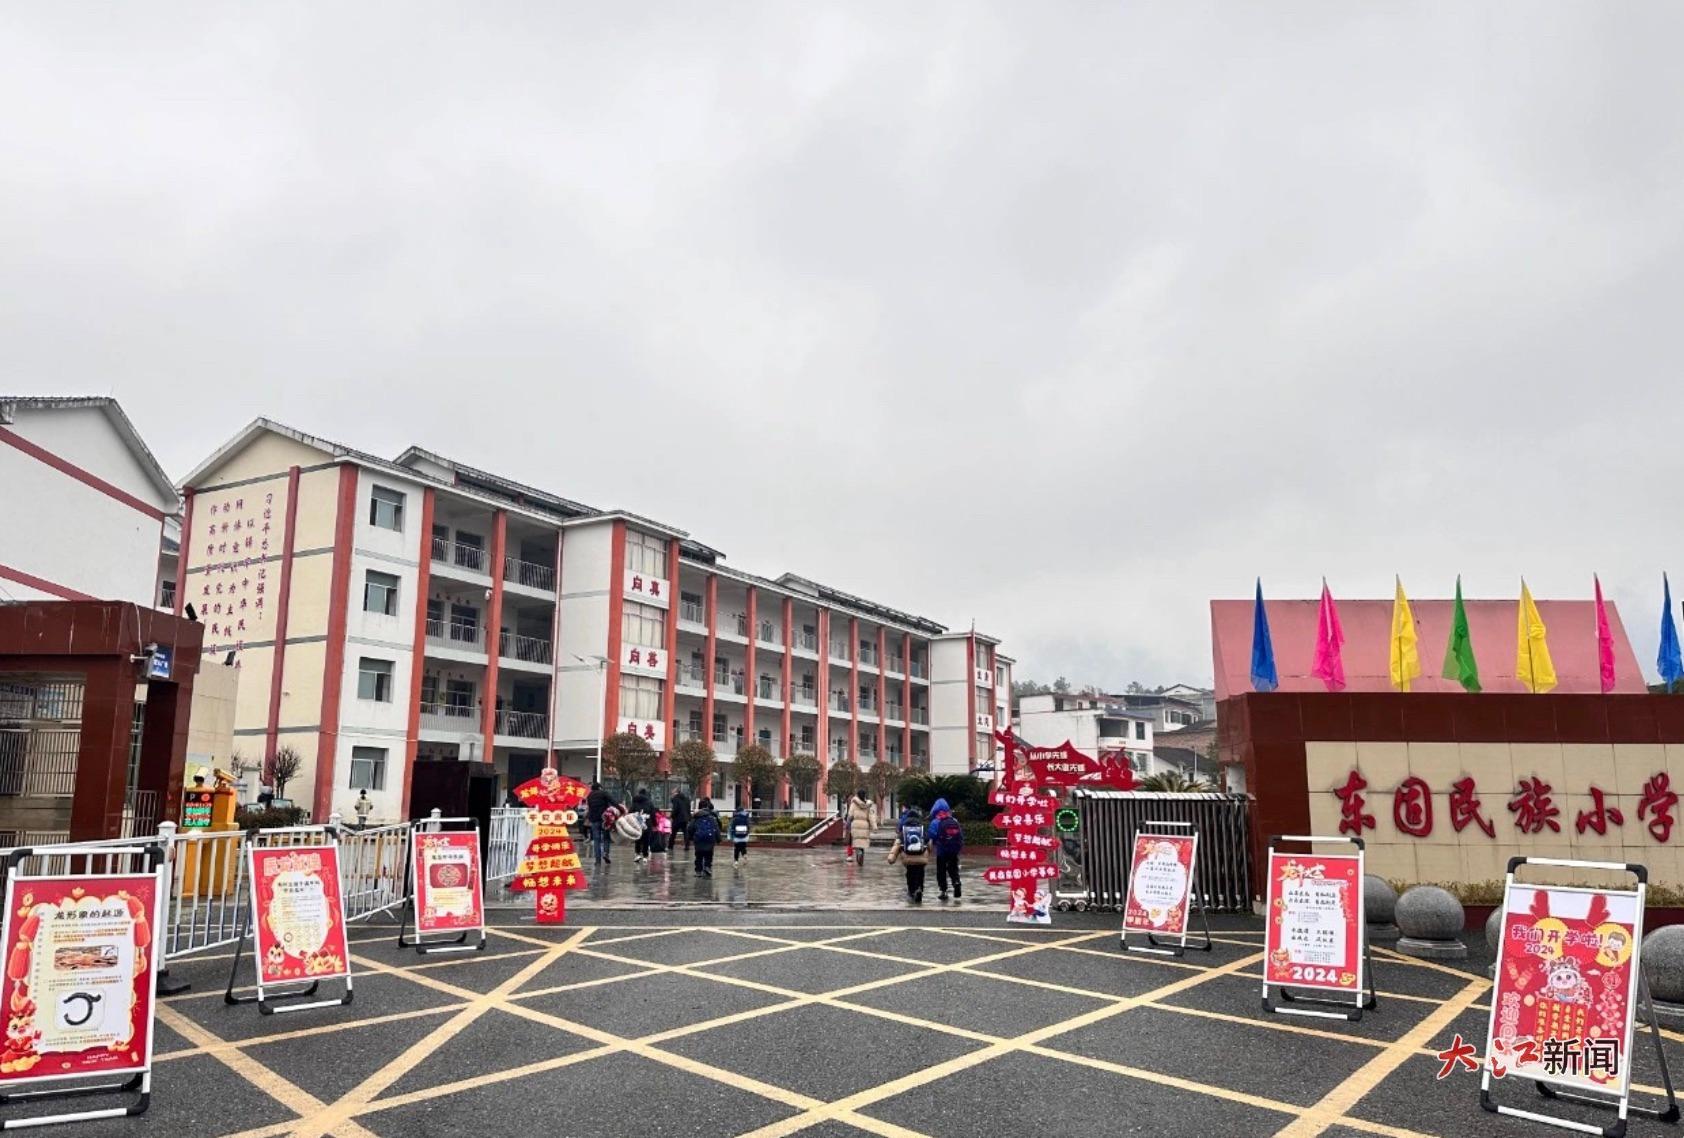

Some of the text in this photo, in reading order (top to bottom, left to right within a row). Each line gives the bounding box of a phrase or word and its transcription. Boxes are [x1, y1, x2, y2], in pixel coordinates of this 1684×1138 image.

[631, 575, 660, 597] 向真
[629, 647, 658, 668] 向善
[627, 721, 655, 741] 向美
[1333, 769, 1679, 843] 东固民族小学
[528, 812, 575, 822] 平安喜乐
[1001, 812, 1046, 826] 平安喜乐
[537, 828, 563, 836] 2024
[531, 841, 571, 853] 开学快乐
[1013, 833, 1053, 847] 梦想起航
[1000, 849, 1037, 861] 畅想未来
[526, 858, 574, 872] 梦想起航
[522, 874, 577, 889] 畅想未来
[1512, 924, 1603, 948] 我们开学啦!
[1526, 943, 1555, 955] 2024
[1292, 966, 1338, 984] 2024
